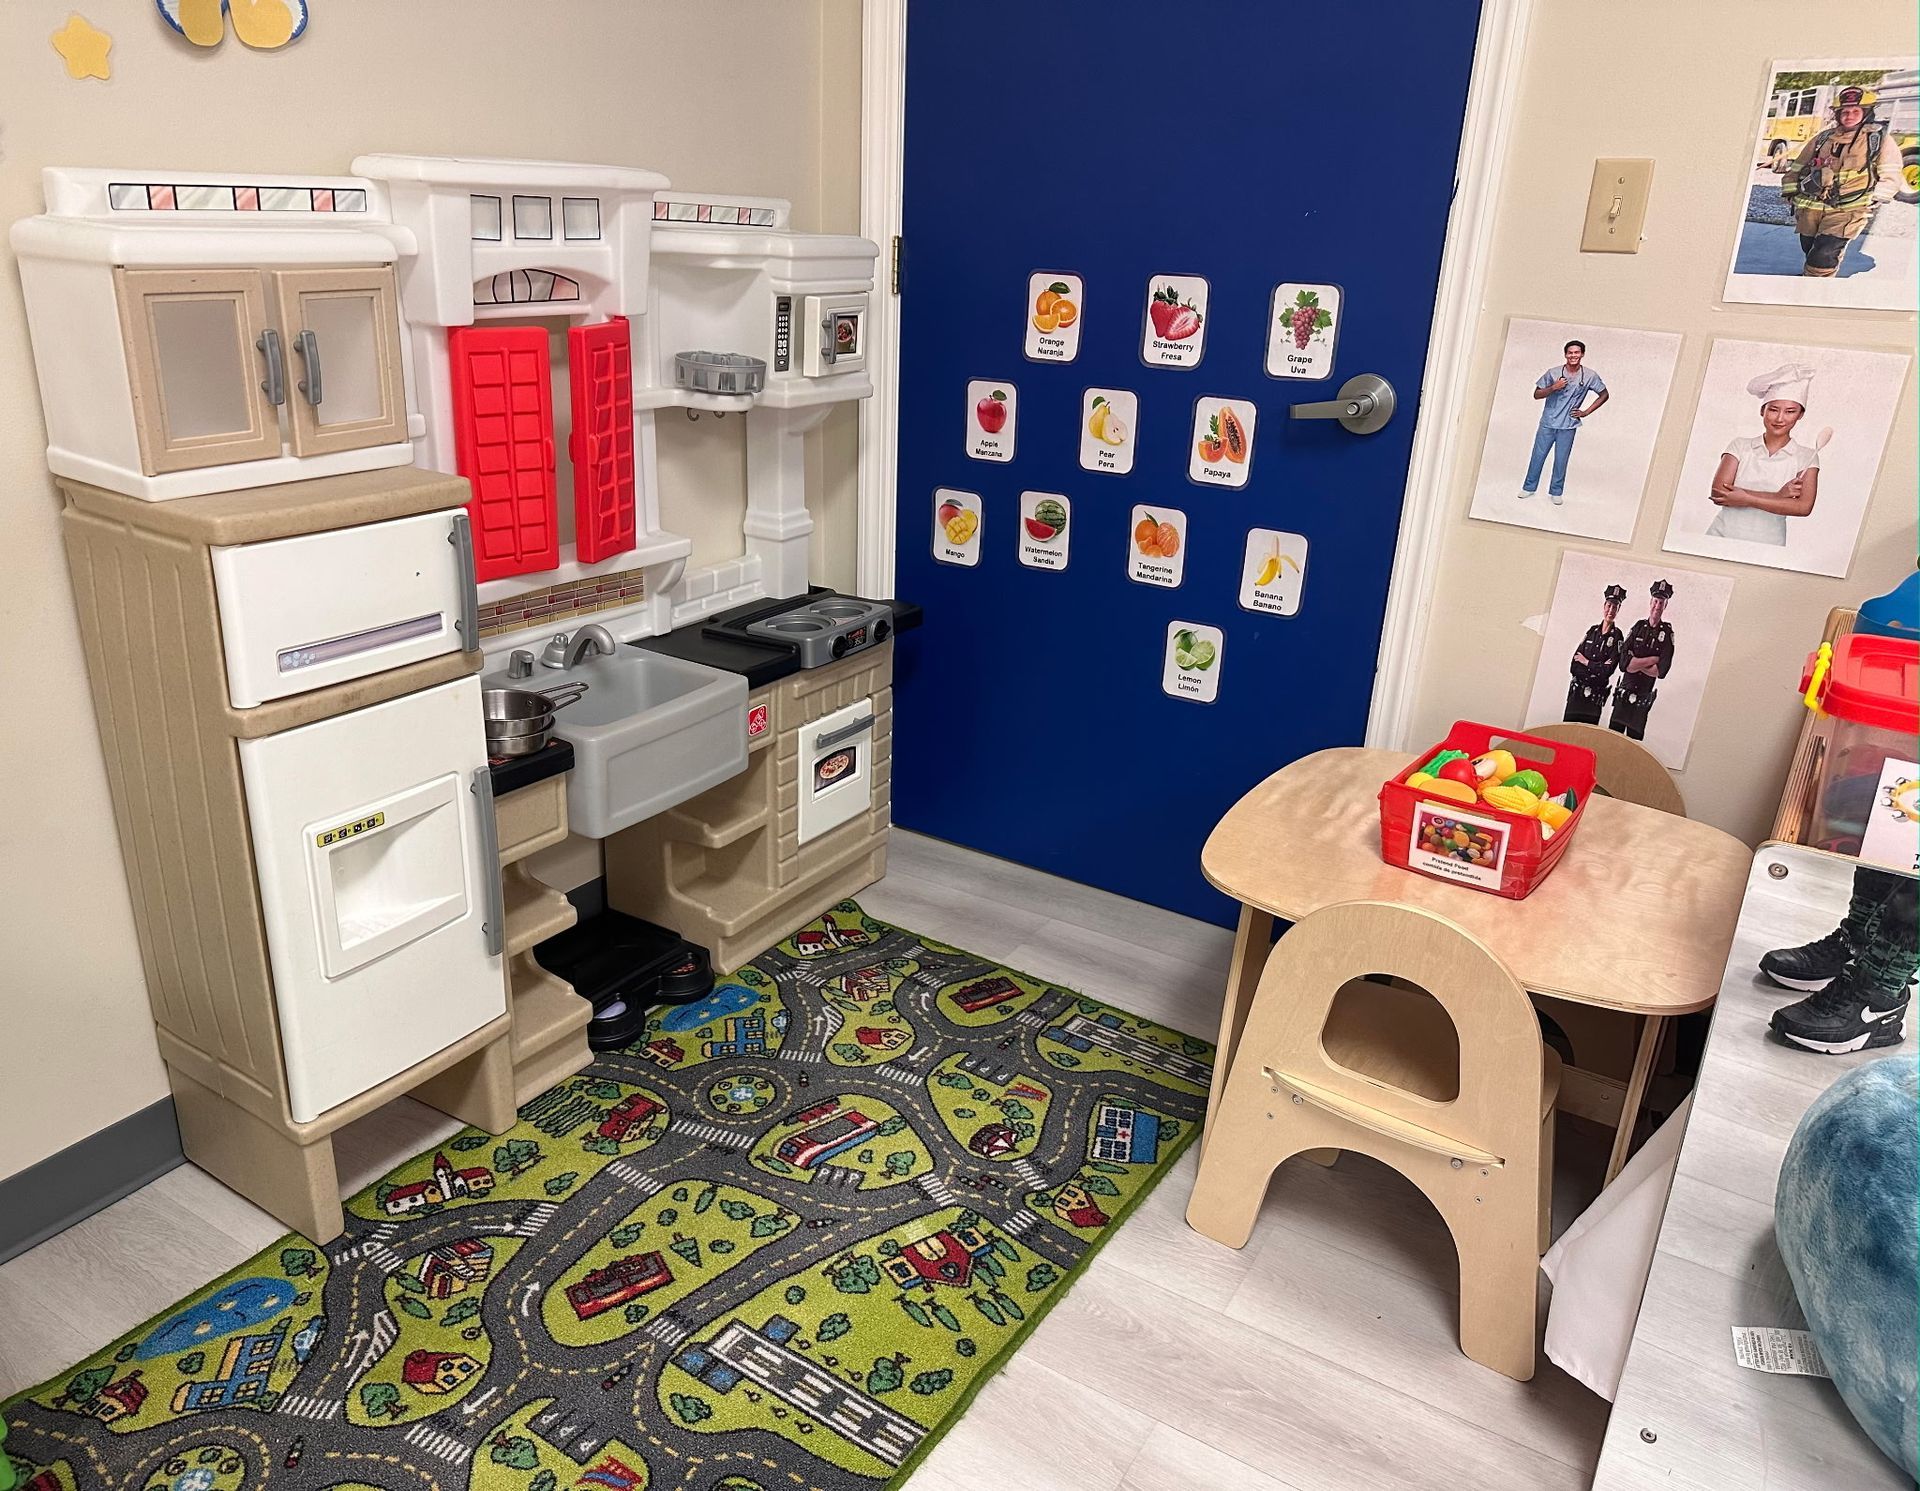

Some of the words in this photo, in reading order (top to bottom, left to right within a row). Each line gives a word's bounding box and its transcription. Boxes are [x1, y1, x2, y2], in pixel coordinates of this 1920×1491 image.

[1039, 337, 1065, 347] Orange
[1152, 340, 1194, 353] Strawberry
[1037, 347, 1064, 357] Naranja
[1161, 352, 1182, 361] Fresa
[1287, 355, 1313, 365] Grape
[1291, 365, 1306, 375] Uva
[980, 439, 999, 448] Apple
[975, 448, 1003, 458] Manzana
[1099, 450, 1115, 459] Pear
[1098, 459, 1115, 469] Pera
[1204, 468, 1232, 479] Papaya
[945, 549, 965, 558] Mango
[1025, 546, 1063, 558] Watermelon
[1138, 562, 1173, 575] Tangerine
[1136, 572, 1173, 584] Mandarina
[1255, 590, 1283, 602] Banana
[1253, 600, 1282, 611] Banano
[1178, 674, 1201, 684] Lemon
[1178, 683, 1199, 693] Limón
[1422, 861, 1442, 871] comida
[1431, 857, 1453, 868] Pretend
[1454, 863, 1469, 871] Food
